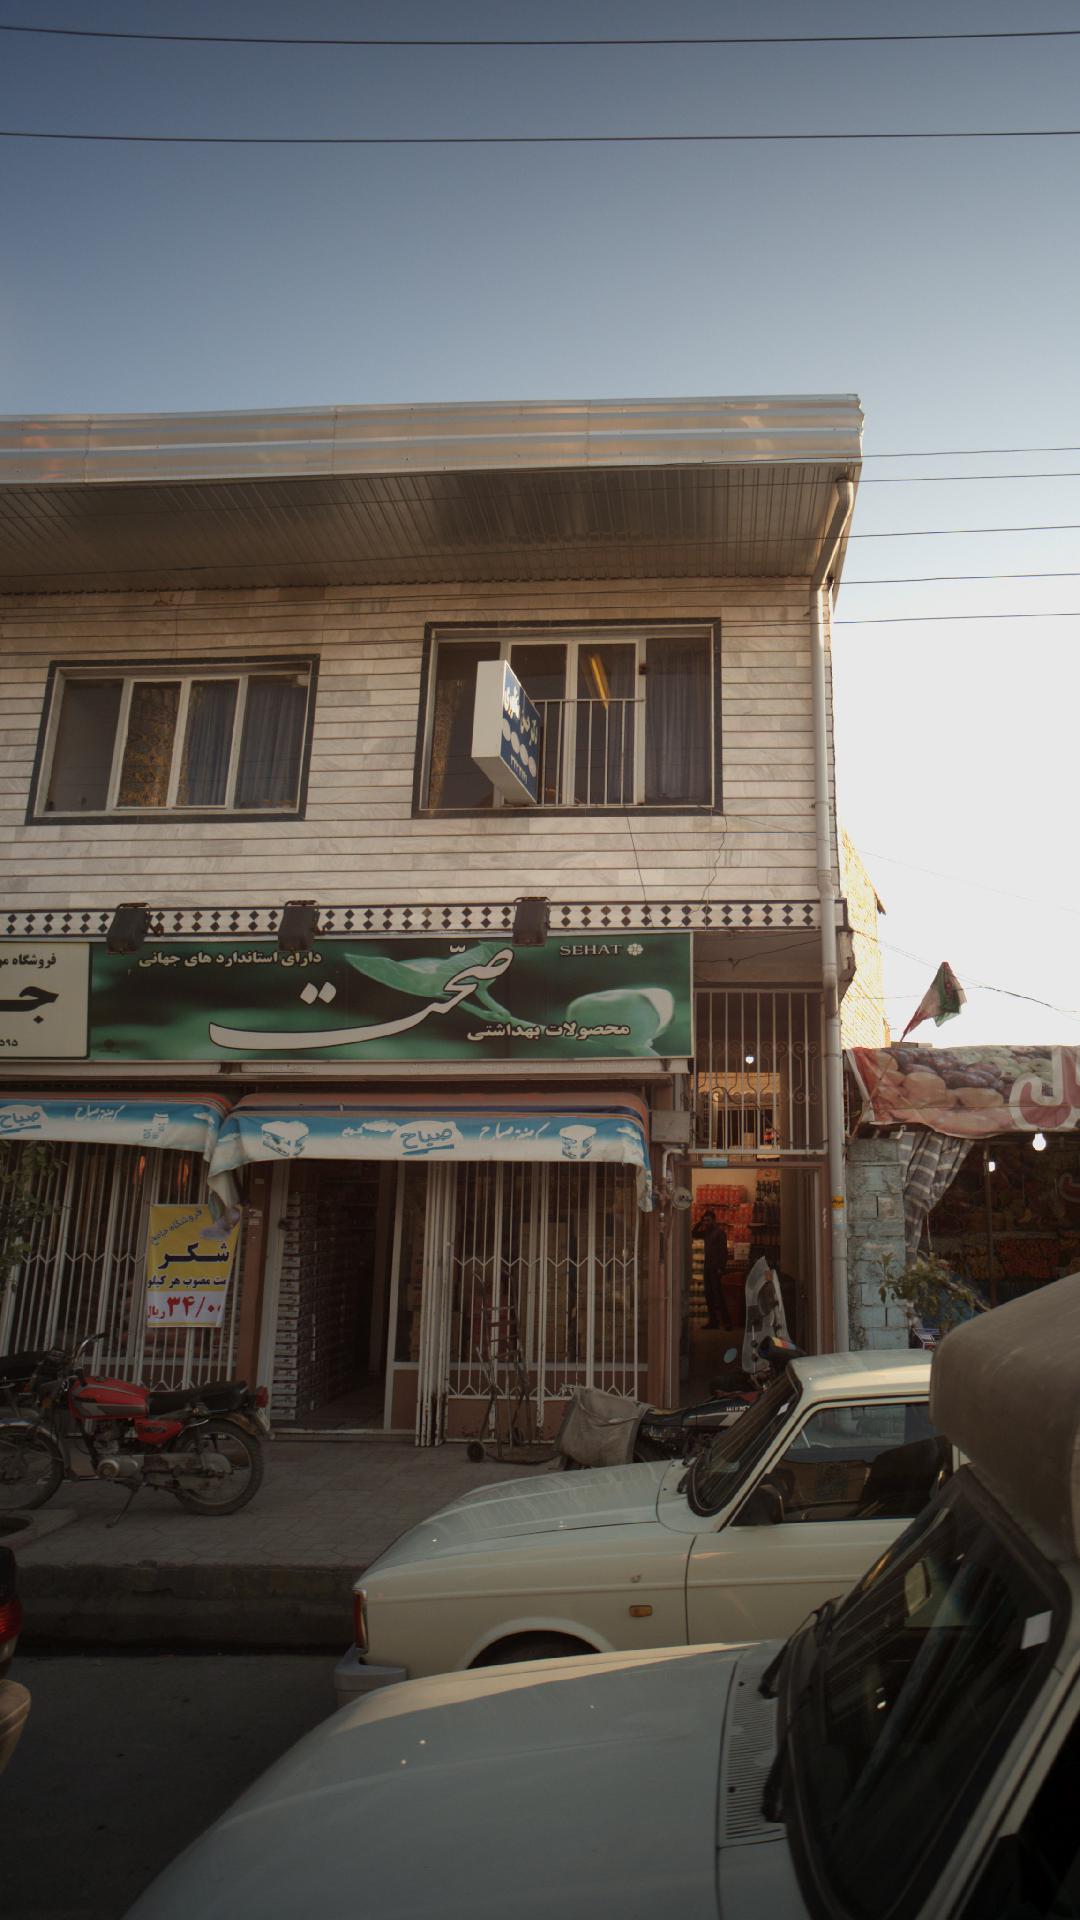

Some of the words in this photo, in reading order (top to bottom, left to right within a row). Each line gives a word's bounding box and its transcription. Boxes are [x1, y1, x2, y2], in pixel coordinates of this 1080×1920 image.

[184, 950, 212, 967] های
[281, 950, 322, 967] دارای
[559, 944, 623, 956] SEHAT
[12, 952, 57, 969] فروشگاه
[139, 951, 180, 968] جهانی
[216, 950, 278, 968] استاندارد
[466, 1023, 542, 1042] بهداشتی
[545, 1021, 631, 1041] محصولات
[0, 1111, 41, 1129] صباح
[400, 1127, 453, 1150] صباح
[158, 1242, 230, 1269] شکر
[147, 1275, 166, 1289] کیلو
[168, 1277, 181, 1288] هر
